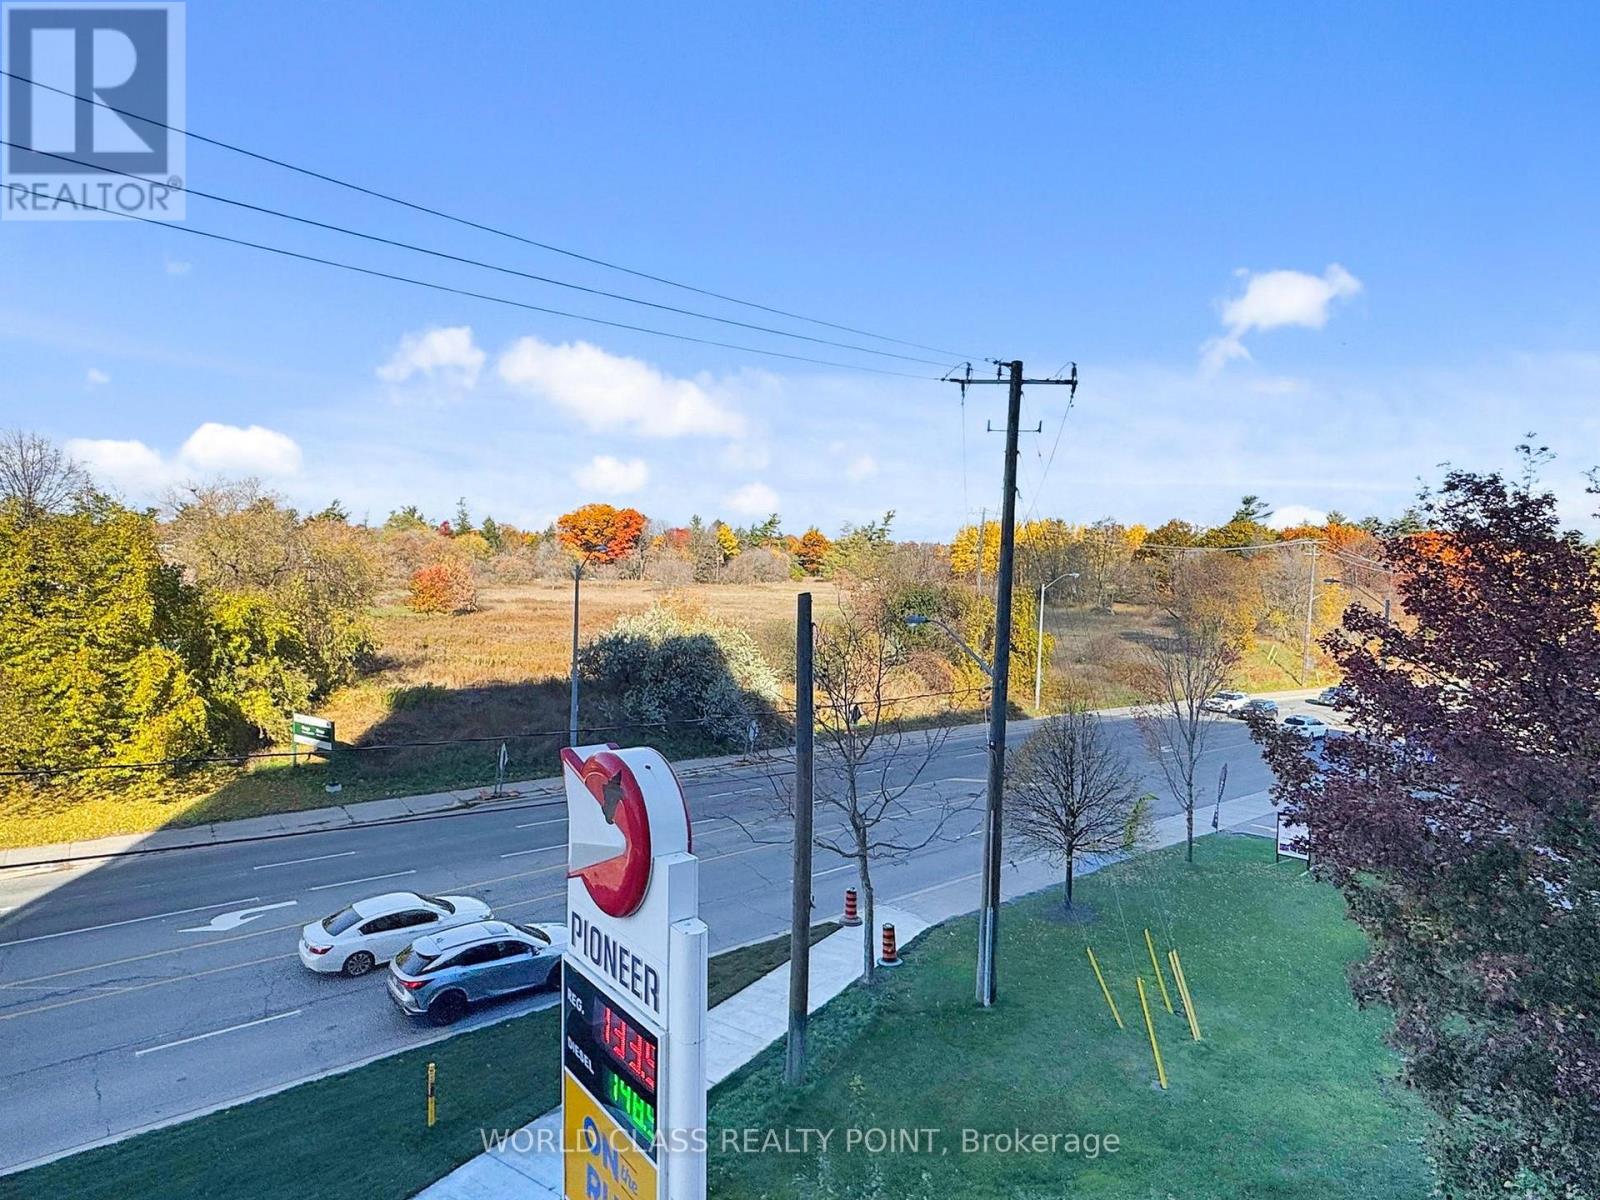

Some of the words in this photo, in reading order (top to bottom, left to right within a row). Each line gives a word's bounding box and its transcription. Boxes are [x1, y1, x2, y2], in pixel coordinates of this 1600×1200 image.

[571, 910, 660, 1014] PIONEER
[567, 987, 585, 1015] REG.
[567, 1035, 595, 1076] DIESEL
[583, 1116, 620, 1184] ON
[621, 1164, 639, 1197] the
